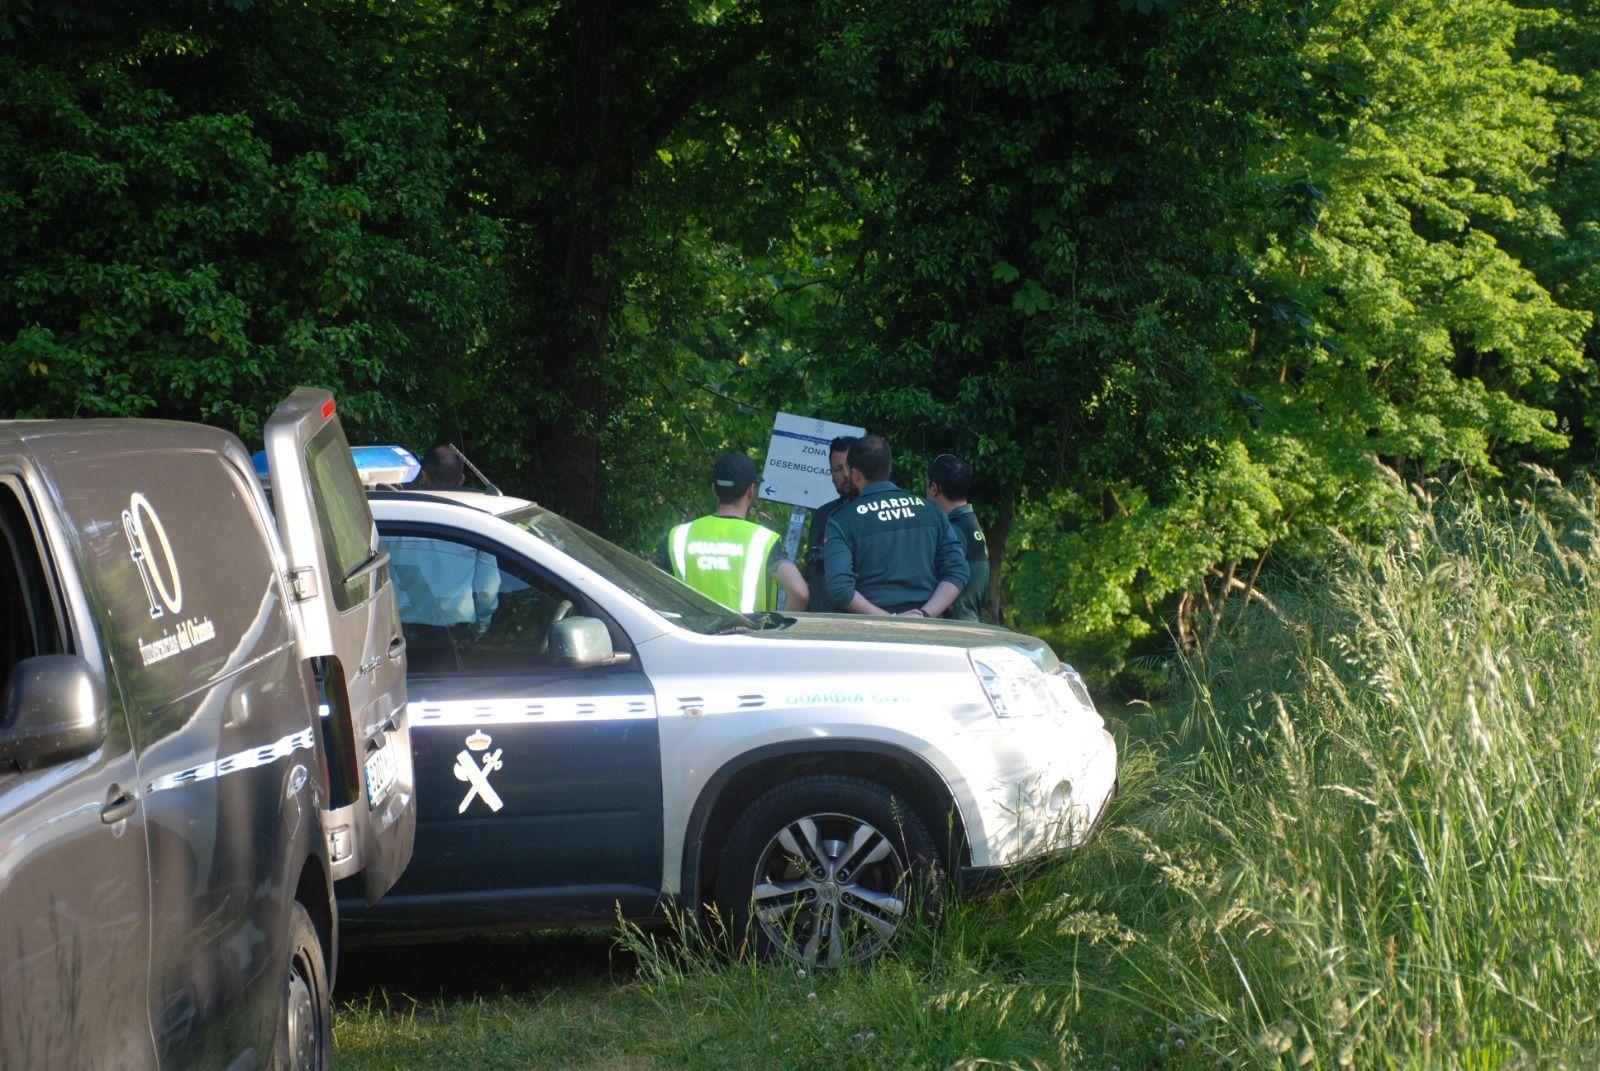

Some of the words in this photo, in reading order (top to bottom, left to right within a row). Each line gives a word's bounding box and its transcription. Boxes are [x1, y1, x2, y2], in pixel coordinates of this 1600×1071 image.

[802, 446, 827, 457] ZONA
[856, 495, 925, 515] GUARDIA
[877, 507, 916, 522] CIVIL
[687, 541, 744, 557] GUARDIA
[697, 556, 730, 571] CIVIL
[785, 691, 865, 705] GUARDIA
